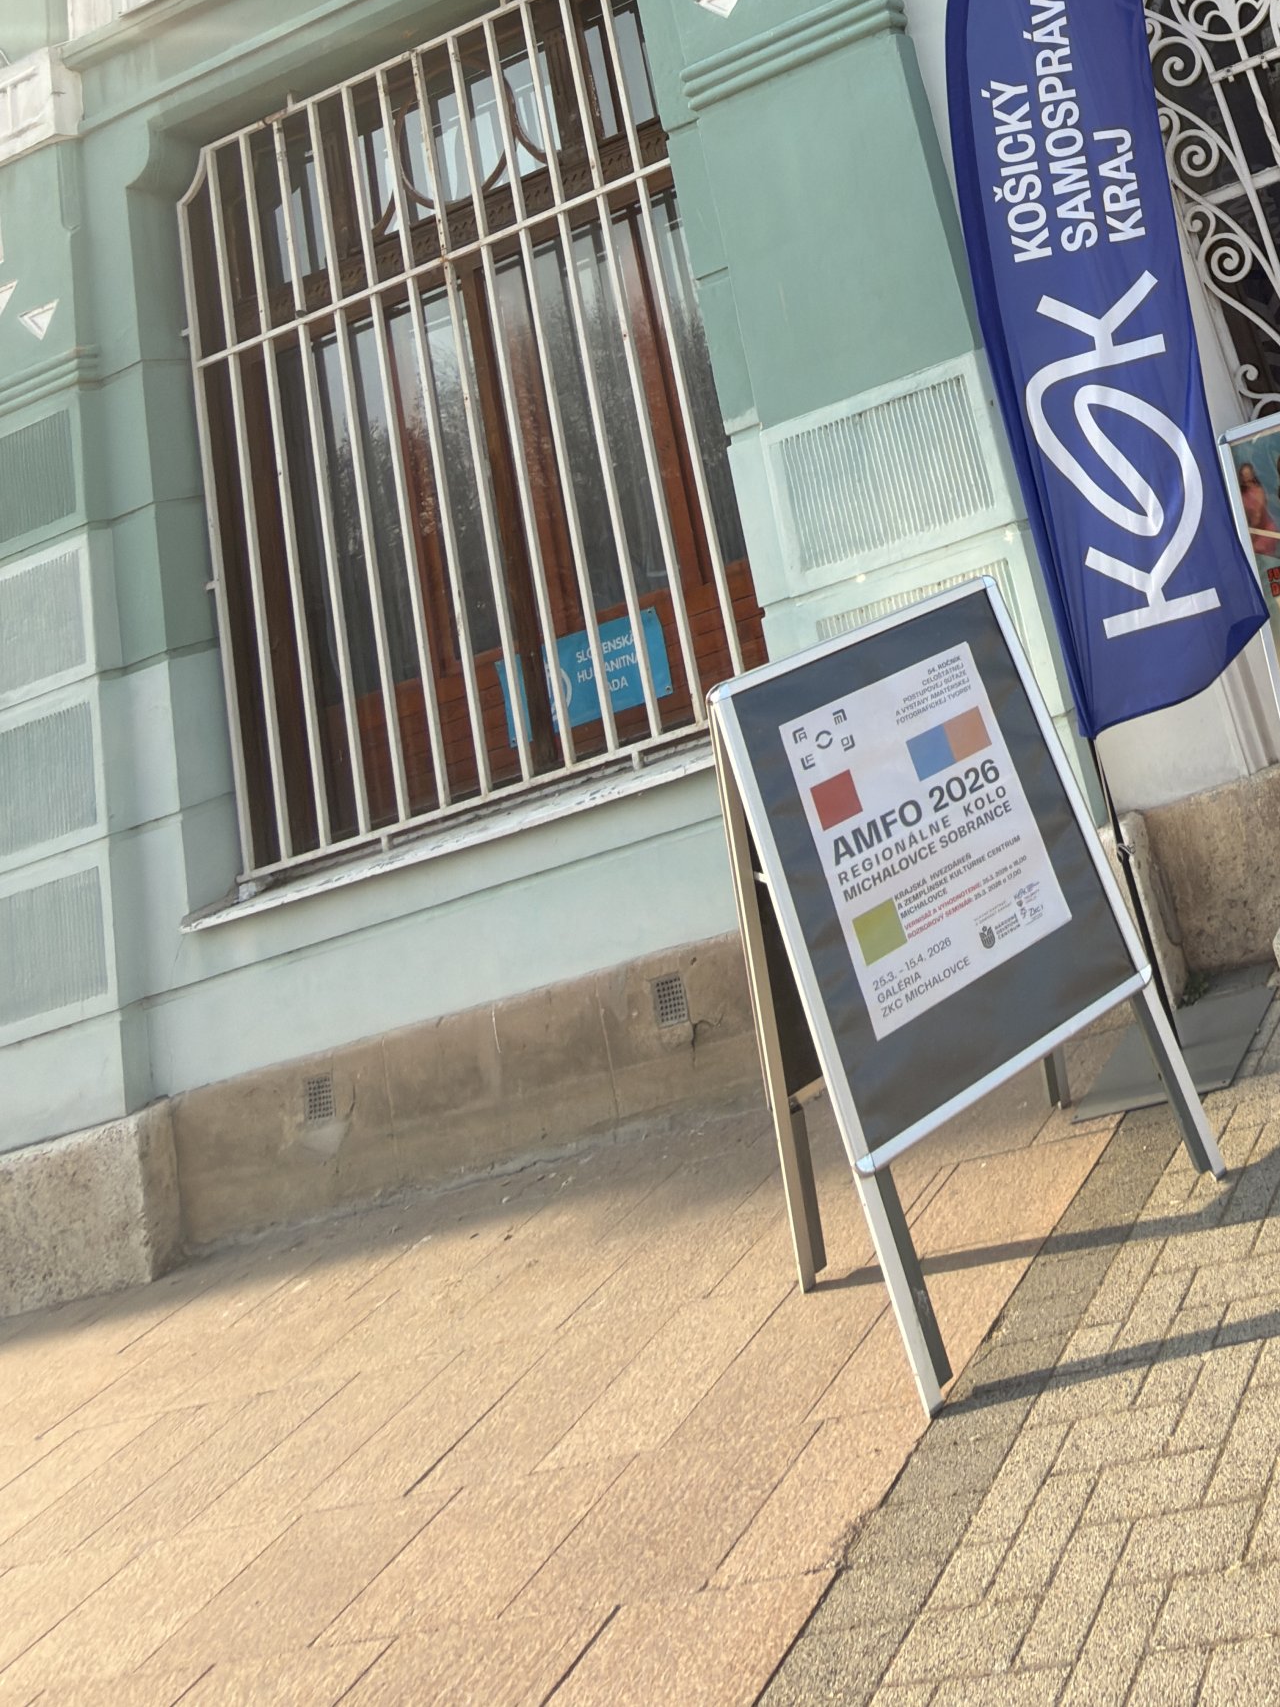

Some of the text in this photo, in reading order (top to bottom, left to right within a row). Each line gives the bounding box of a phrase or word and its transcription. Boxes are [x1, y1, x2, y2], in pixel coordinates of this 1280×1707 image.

[981, 80, 1053, 263] KOŠICKÝ
[1093, 128, 1146, 243] KRAJ
[833, 759, 1000, 866] AMFO 2026
[837, 786, 1007, 886] REGIONÁLNE KOLO
[843, 800, 1012, 902] MICHALOVCE SOBRANCE
[900, 887, 948, 919] MICHALOVCE
[904, 878, 949, 907] ZEMPLÍNSKE
[986, 835, 1021, 859] CENTRUM
[872, 971, 897, 991] 25.3.
[905, 953, 926, 971] 15.4.
[927, 937, 952, 958] 2026
[877, 971, 922, 1004] GALÉRIA
[881, 956, 971, 1018] ZKC MICHALOVCE
